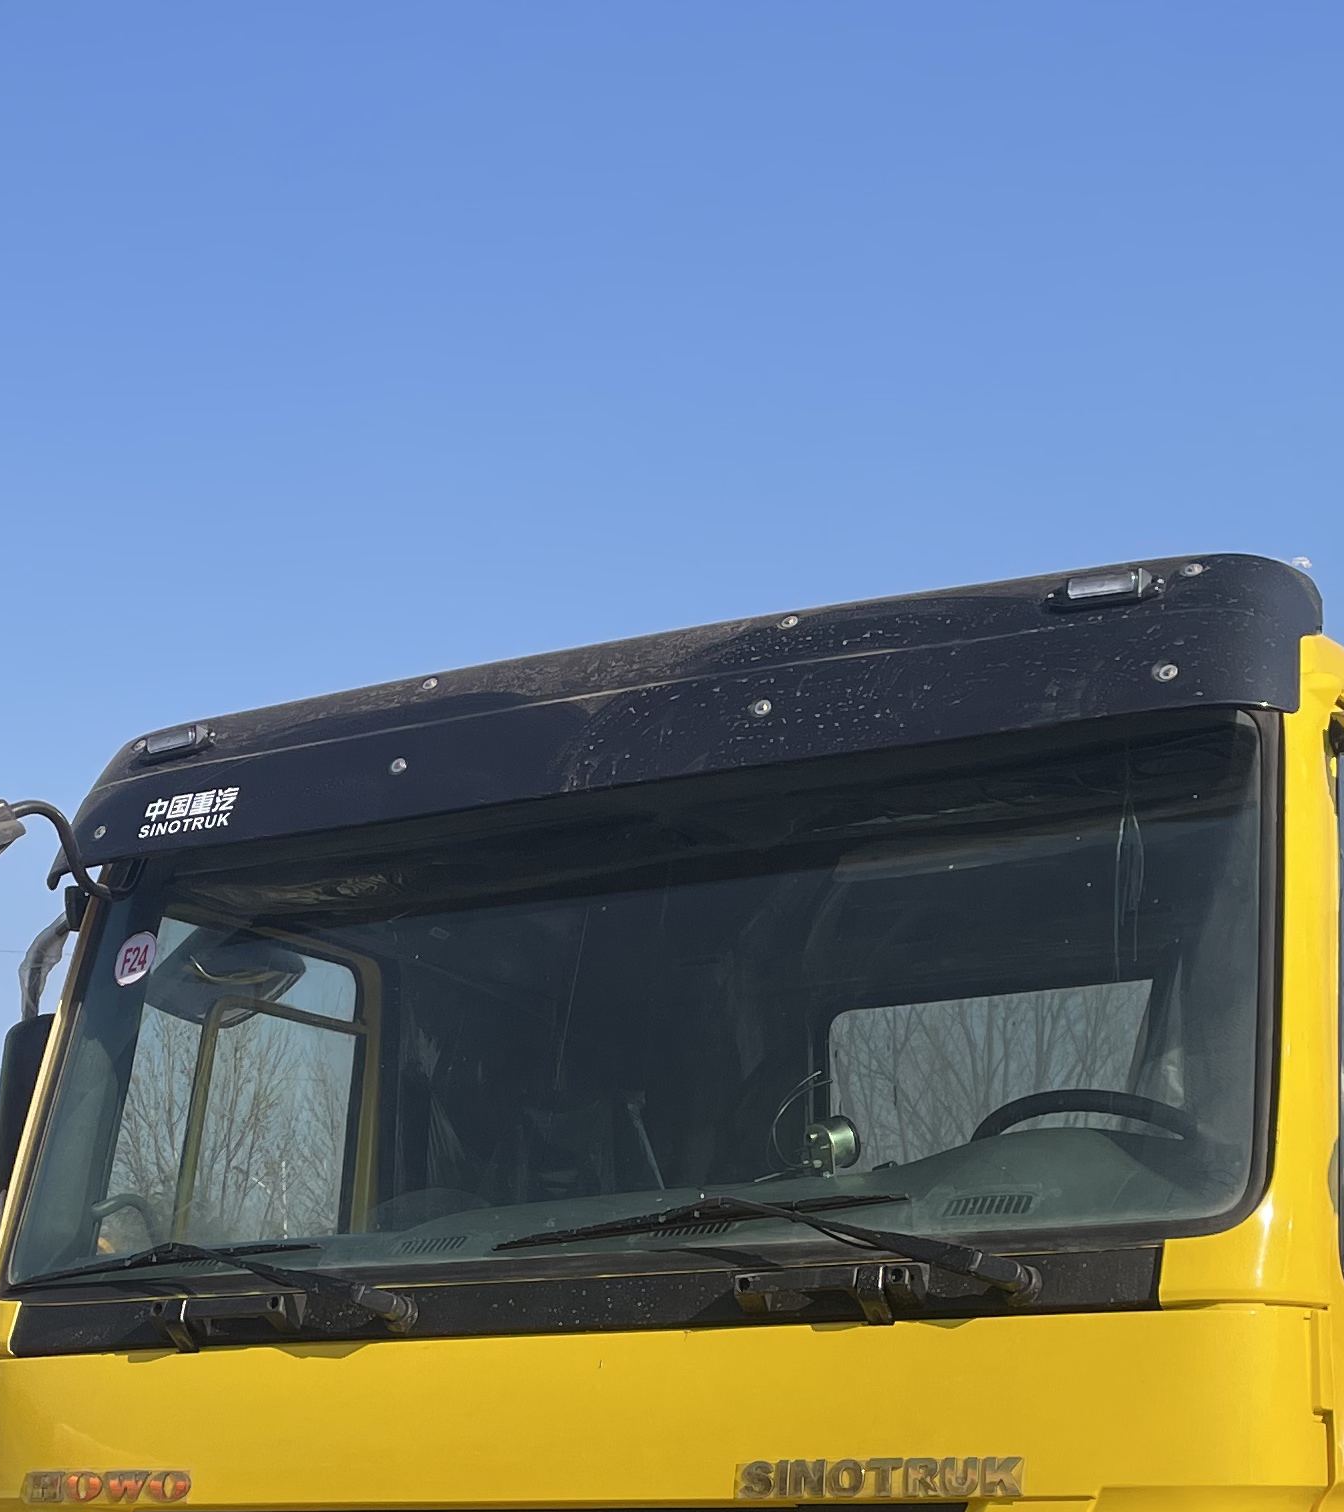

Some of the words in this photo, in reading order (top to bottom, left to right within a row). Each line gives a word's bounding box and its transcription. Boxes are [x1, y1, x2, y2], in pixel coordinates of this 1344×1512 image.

[145, 787, 240, 821] 中国重汽
[138, 812, 231, 838] SINOTRUK
[120, 944, 149, 977] F24
[25, 1470, 192, 1504] HOWO
[737, 1456, 1023, 1499] SINOTRUK
